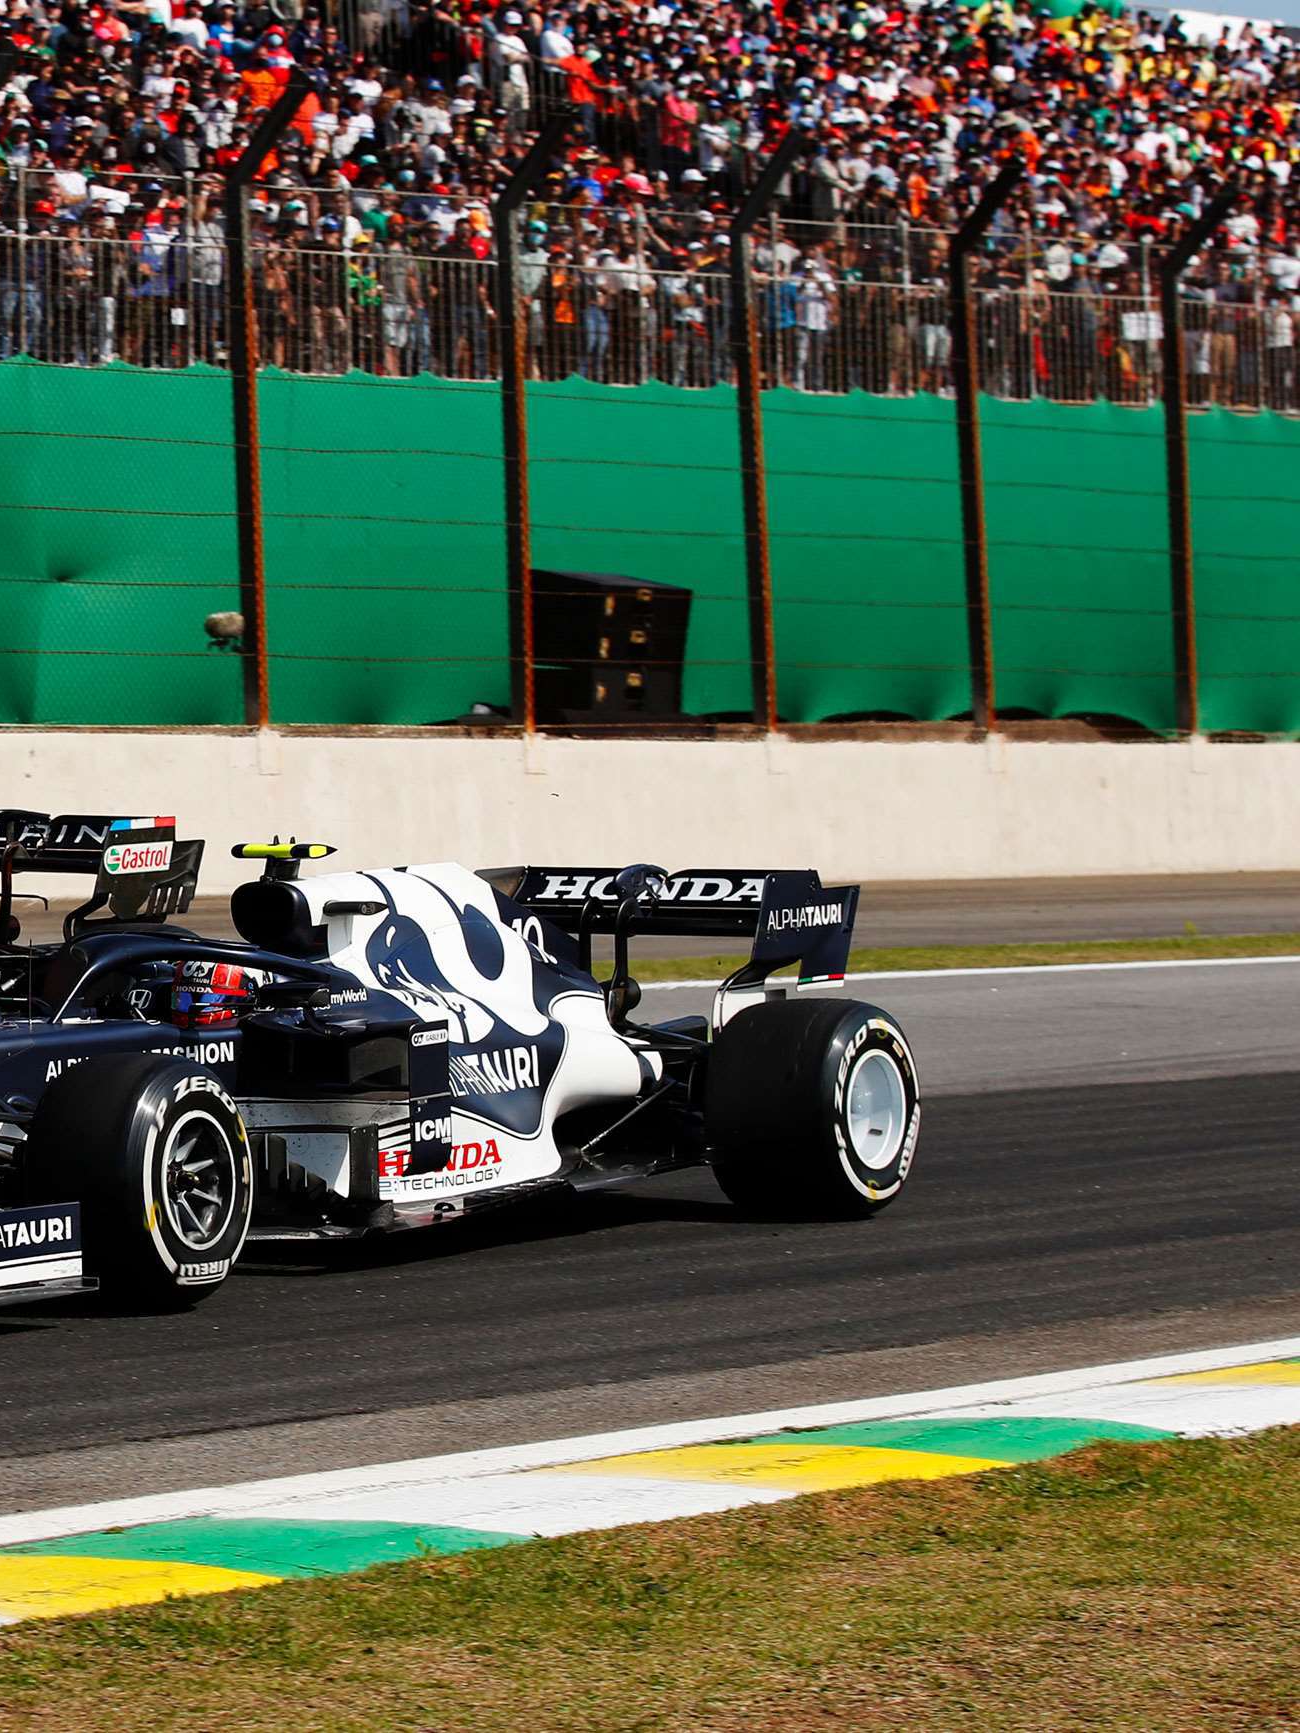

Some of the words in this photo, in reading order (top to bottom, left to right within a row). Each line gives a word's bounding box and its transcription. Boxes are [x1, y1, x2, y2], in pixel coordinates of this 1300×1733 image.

[121, 847, 167, 870] Castrol
[766, 903, 843, 931] ALPHATAURI
[331, 987, 368, 1005] myWorld
[834, 1024, 868, 1115] ZERO
[156, 1097, 168, 1132] P
[173, 1076, 237, 1115] ZERO
[415, 1117, 452, 1142] ICM
[176, 1259, 231, 1286] PIRELLI
